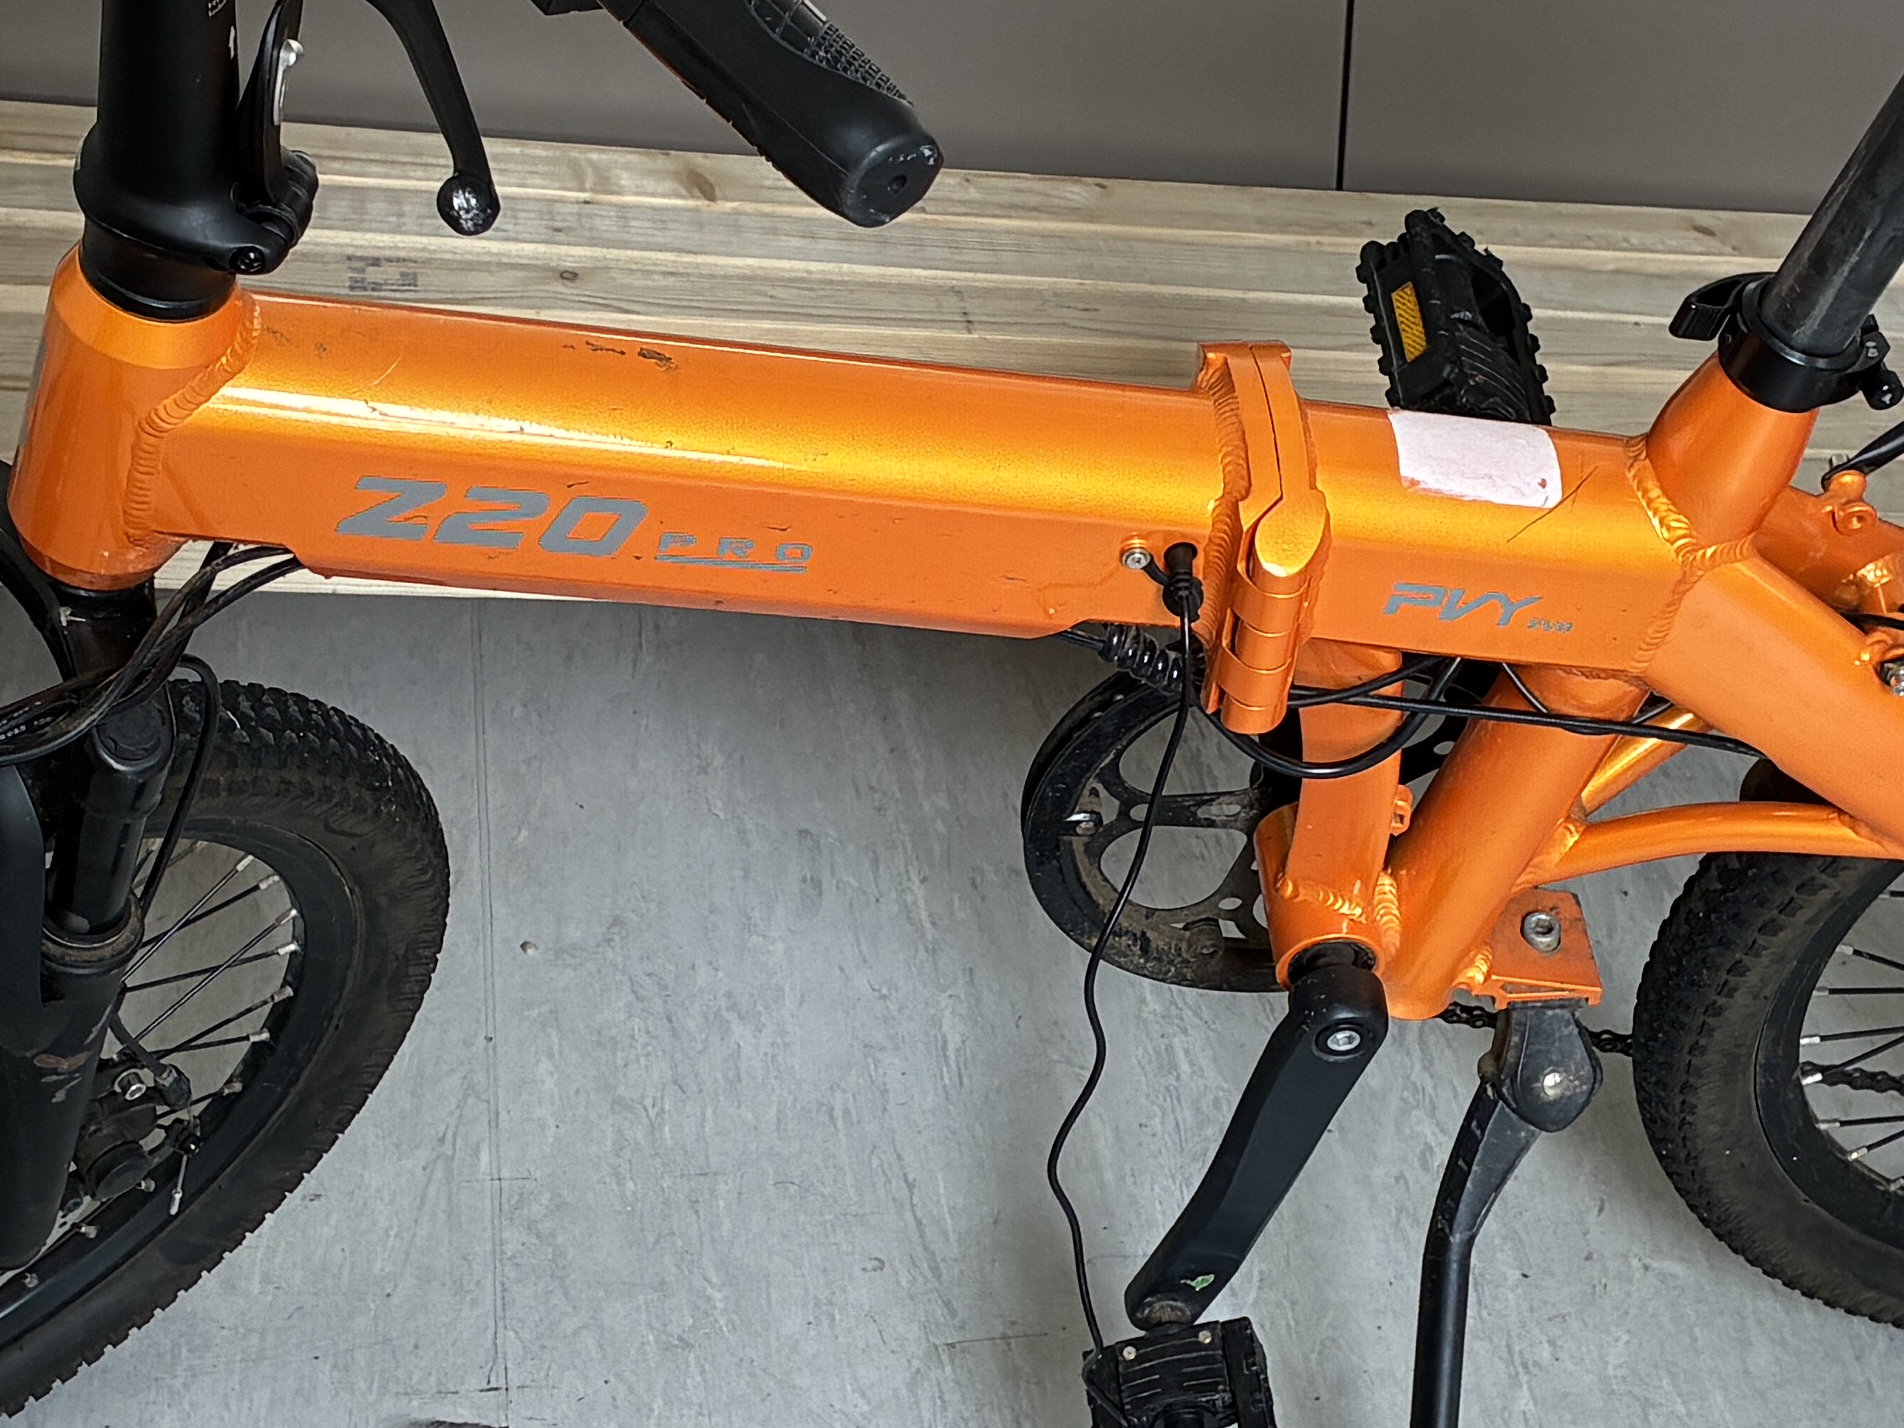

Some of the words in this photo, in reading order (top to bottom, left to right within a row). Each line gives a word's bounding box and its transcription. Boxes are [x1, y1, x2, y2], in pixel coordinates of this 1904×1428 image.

[335, 475, 649, 557] Z20
[656, 531, 815, 565] PRO
[1382, 582, 1543, 628] PVY
